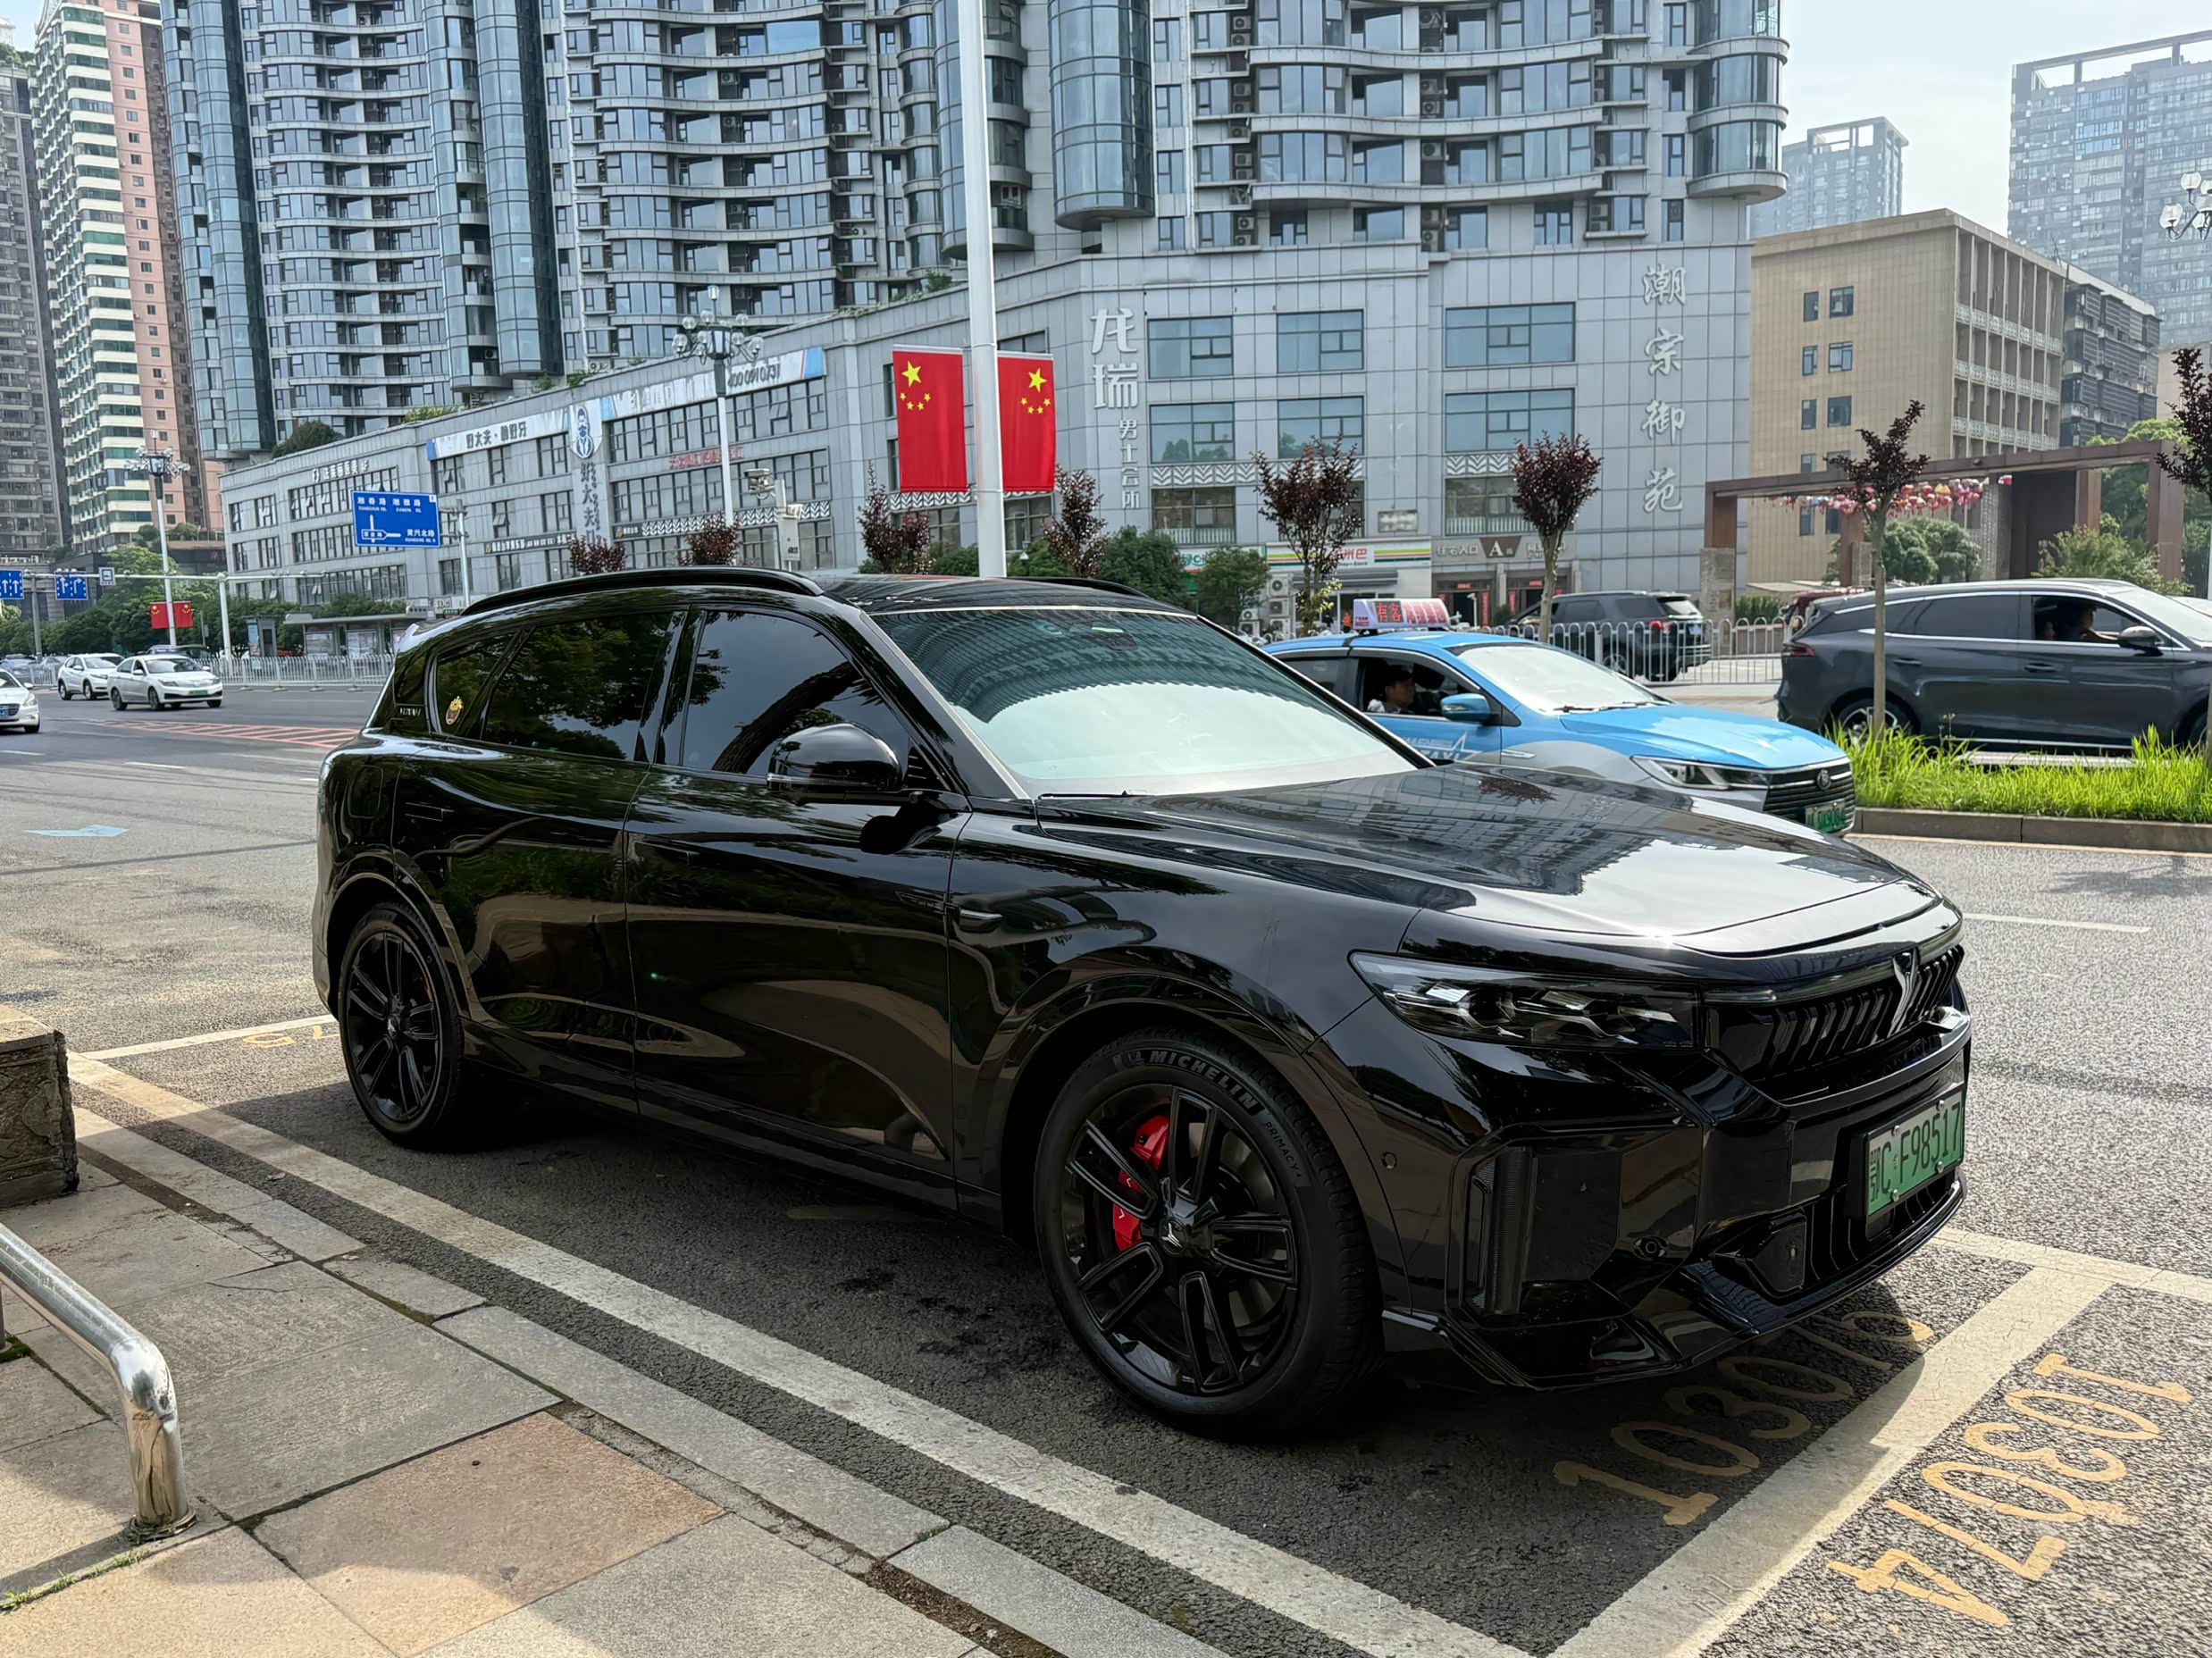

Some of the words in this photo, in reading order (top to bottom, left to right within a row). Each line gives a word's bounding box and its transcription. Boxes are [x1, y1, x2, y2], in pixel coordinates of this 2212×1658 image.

[1090, 307, 1139, 410] 龙瑞
[1642, 264, 1687, 511] 潮宗御苑
[1119, 419, 1140, 509] 男士会所
[407, 529, 435, 537] 黄兴北路
[1437, 544, 1479, 556] 住宅入口
[1149, 1051, 1260, 1110] MICHELIN
[1264, 1121, 1300, 1173] PRIMACY
[1899, 1101, 1961, 1185] F98517
[1827, 1353, 2193, 1627] 103074
